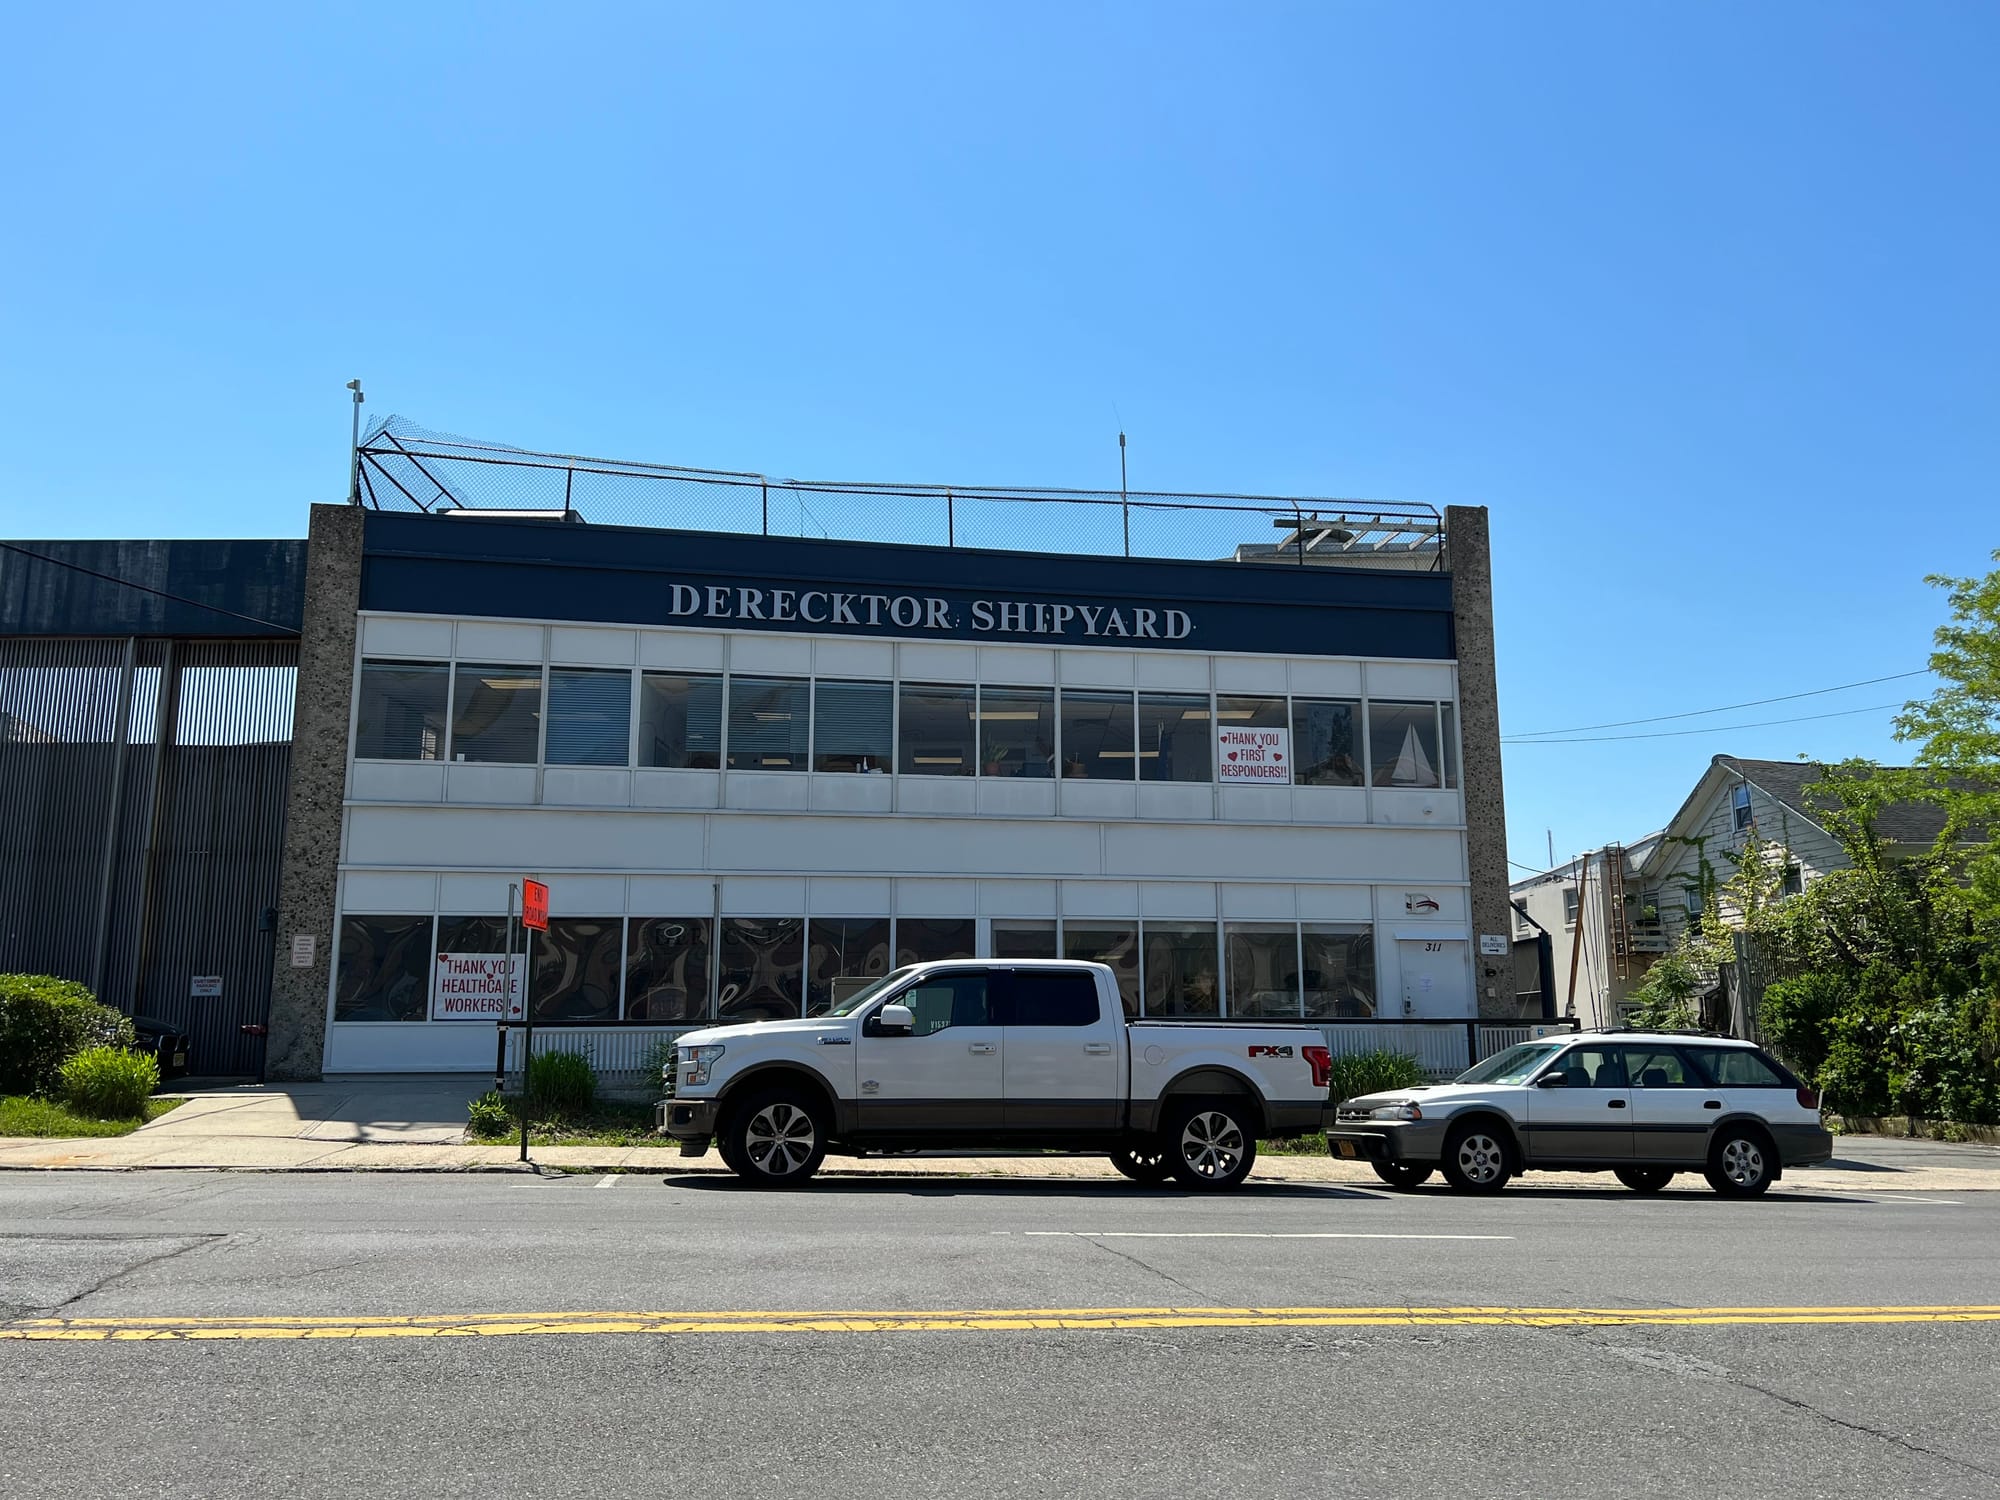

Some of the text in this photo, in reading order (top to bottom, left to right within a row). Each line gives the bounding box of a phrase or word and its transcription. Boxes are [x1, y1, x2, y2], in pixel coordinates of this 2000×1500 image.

[669, 584, 1192, 639] DERECKTOR SHIPYARD
[1226, 732, 1278, 745] THANK YOU
[1240, 749, 1266, 761] FIRST
[1221, 764, 1287, 778] RESPONDERS!!
[1425, 942, 1442, 952] 311
[446, 959, 516, 975] THANK YOU
[441, 979, 517, 993] HEALTHCAE
[444, 998, 512, 1012] WORKERS!
[1248, 1045, 1293, 1057] FX4
